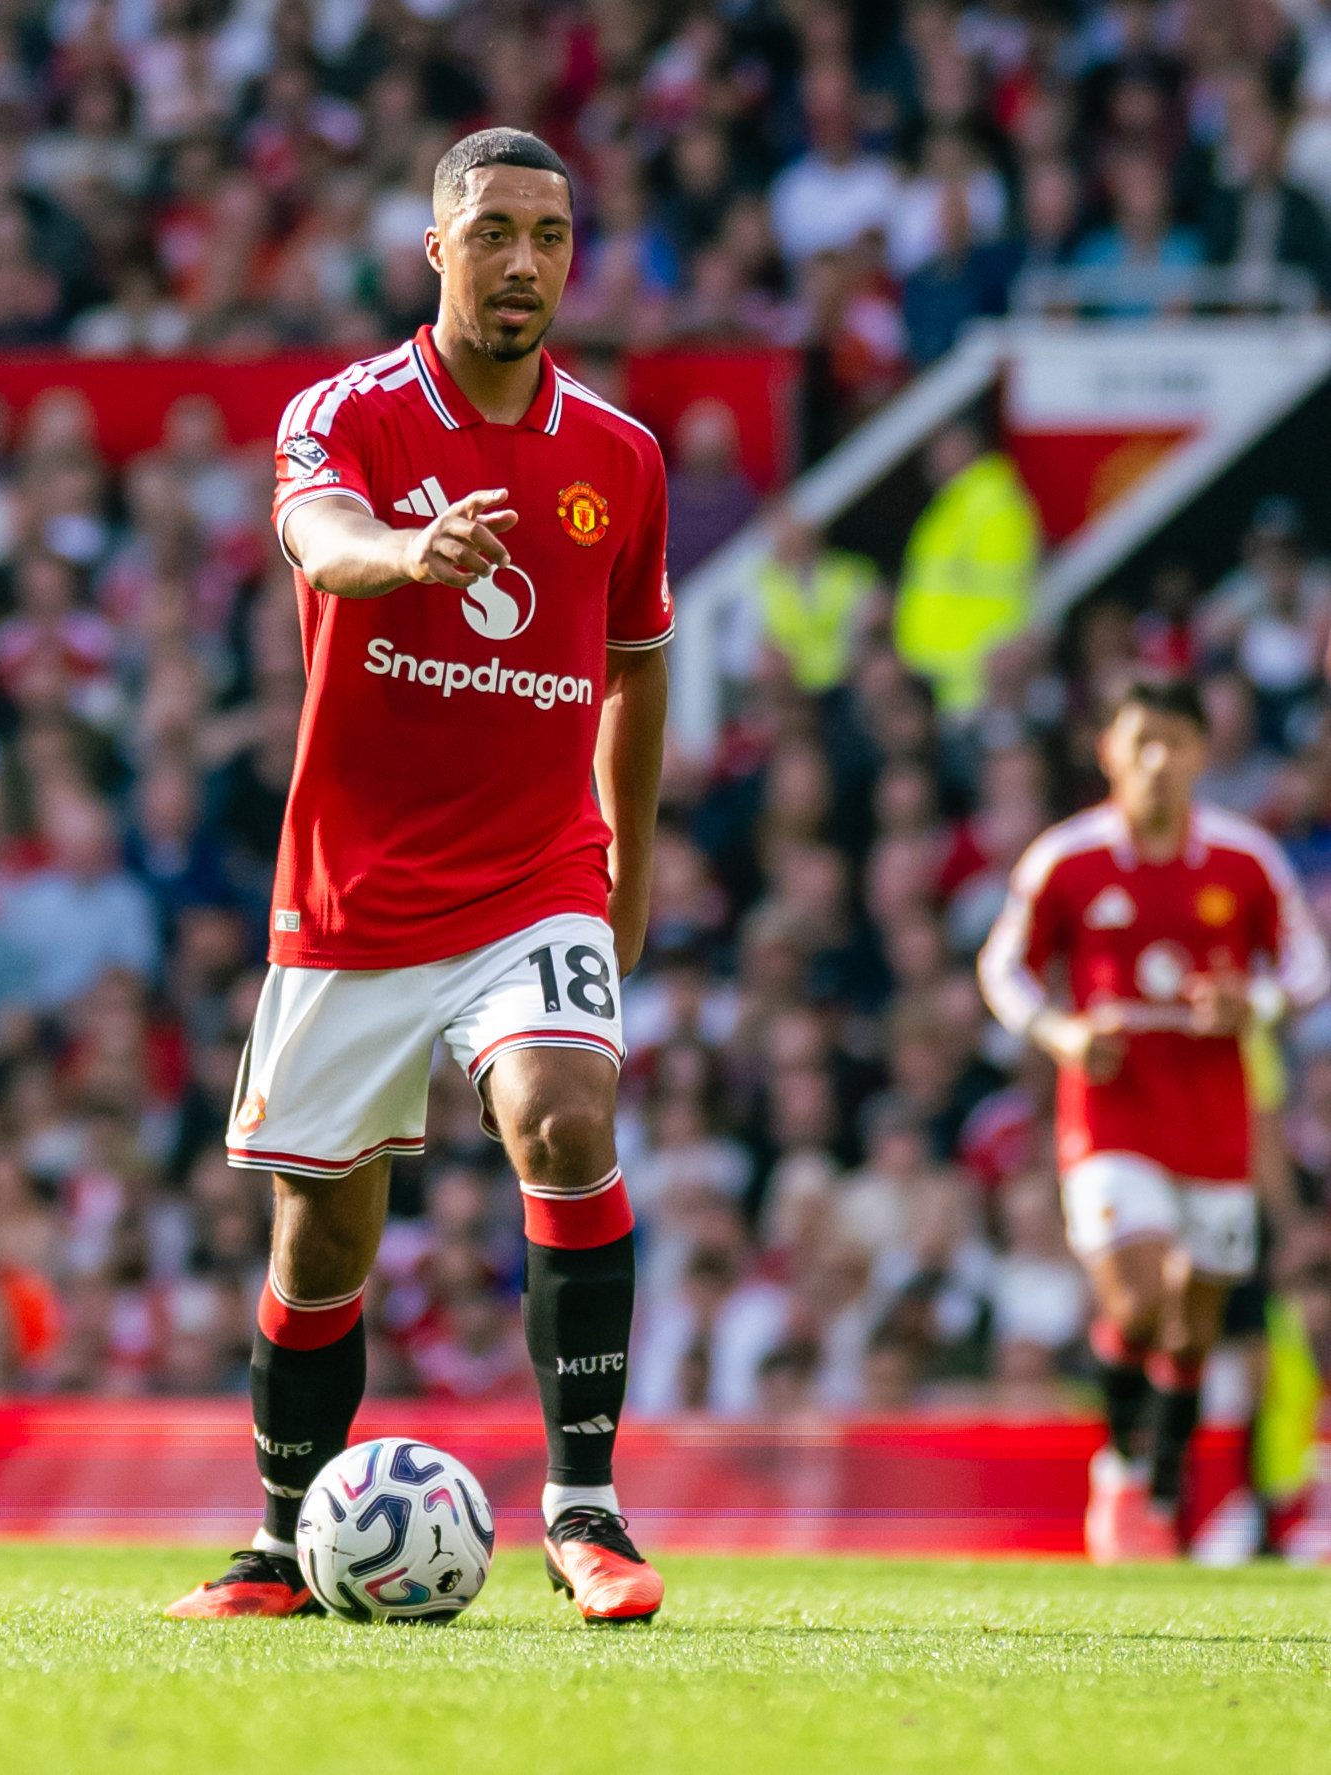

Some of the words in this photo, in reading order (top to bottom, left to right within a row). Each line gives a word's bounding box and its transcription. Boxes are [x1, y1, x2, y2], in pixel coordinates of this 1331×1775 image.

[364, 638, 592, 710] Snapdragon
[529, 945, 616, 1020] 18
[556, 1352, 624, 1376] MUFC
